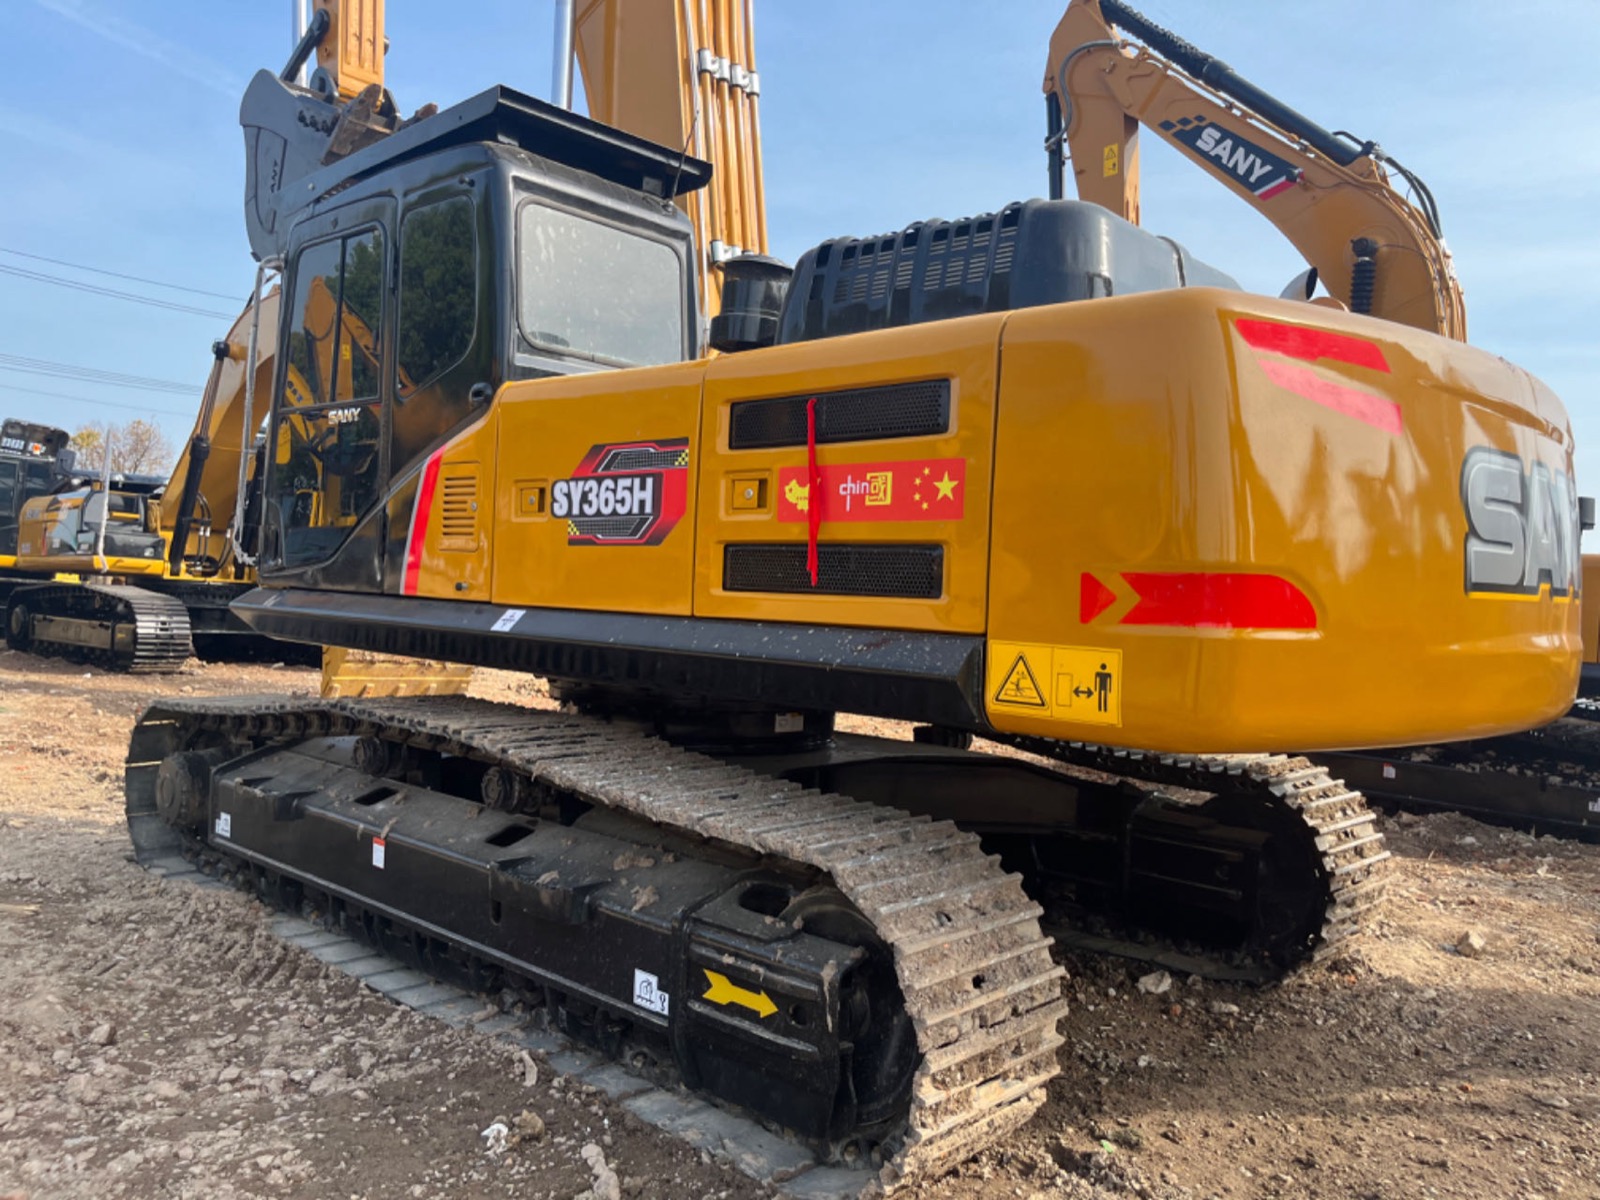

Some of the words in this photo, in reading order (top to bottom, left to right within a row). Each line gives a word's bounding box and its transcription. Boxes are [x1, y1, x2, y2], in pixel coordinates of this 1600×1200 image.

[1195, 126, 1273, 183] SANY
[328, 407, 361, 425] SANY
[553, 477, 653, 517] SY365H
